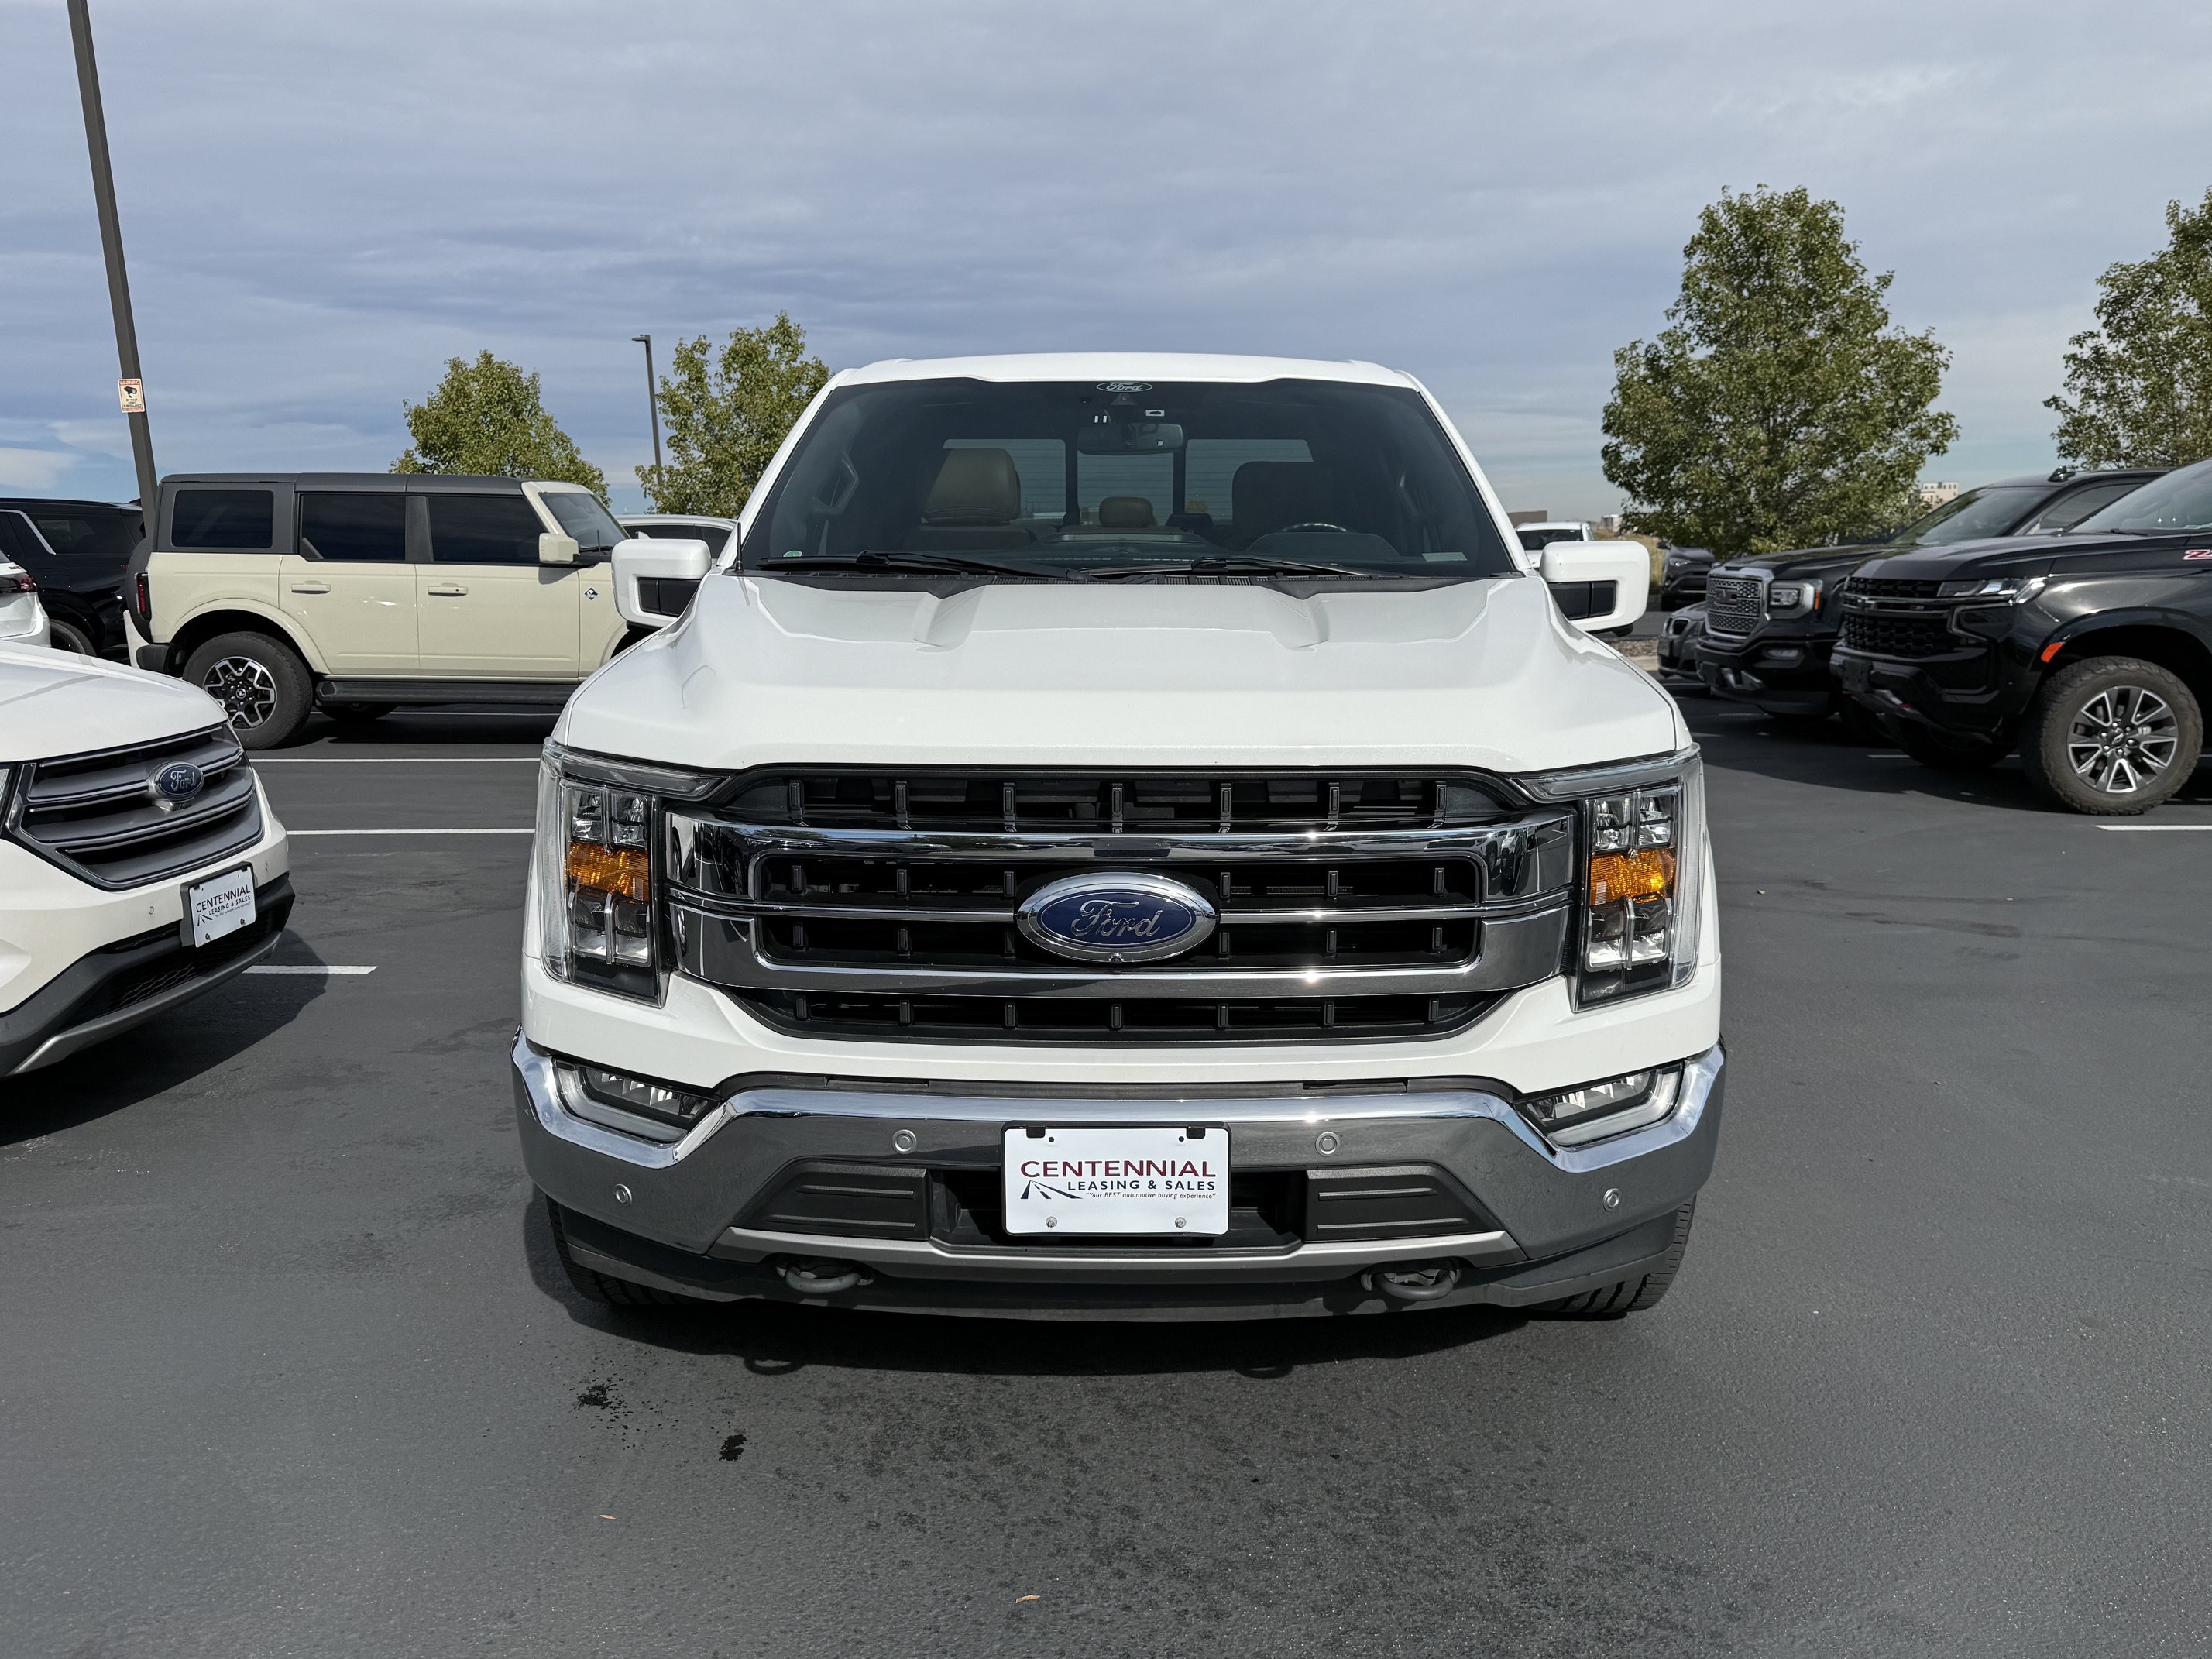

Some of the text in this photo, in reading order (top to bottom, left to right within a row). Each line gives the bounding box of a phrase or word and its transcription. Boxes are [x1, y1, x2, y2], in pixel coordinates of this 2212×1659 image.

[170, 769, 197, 791] Ford
[196, 884, 251, 913] CENTENNIAL
[208, 903, 229, 916] LEASING
[235, 895, 251, 905] SALES
[1070, 899, 1163, 937] Ford
[1020, 1160, 1216, 1178] CENTENNIAL
[1067, 1180, 1215, 1190] LEASING & SALES
